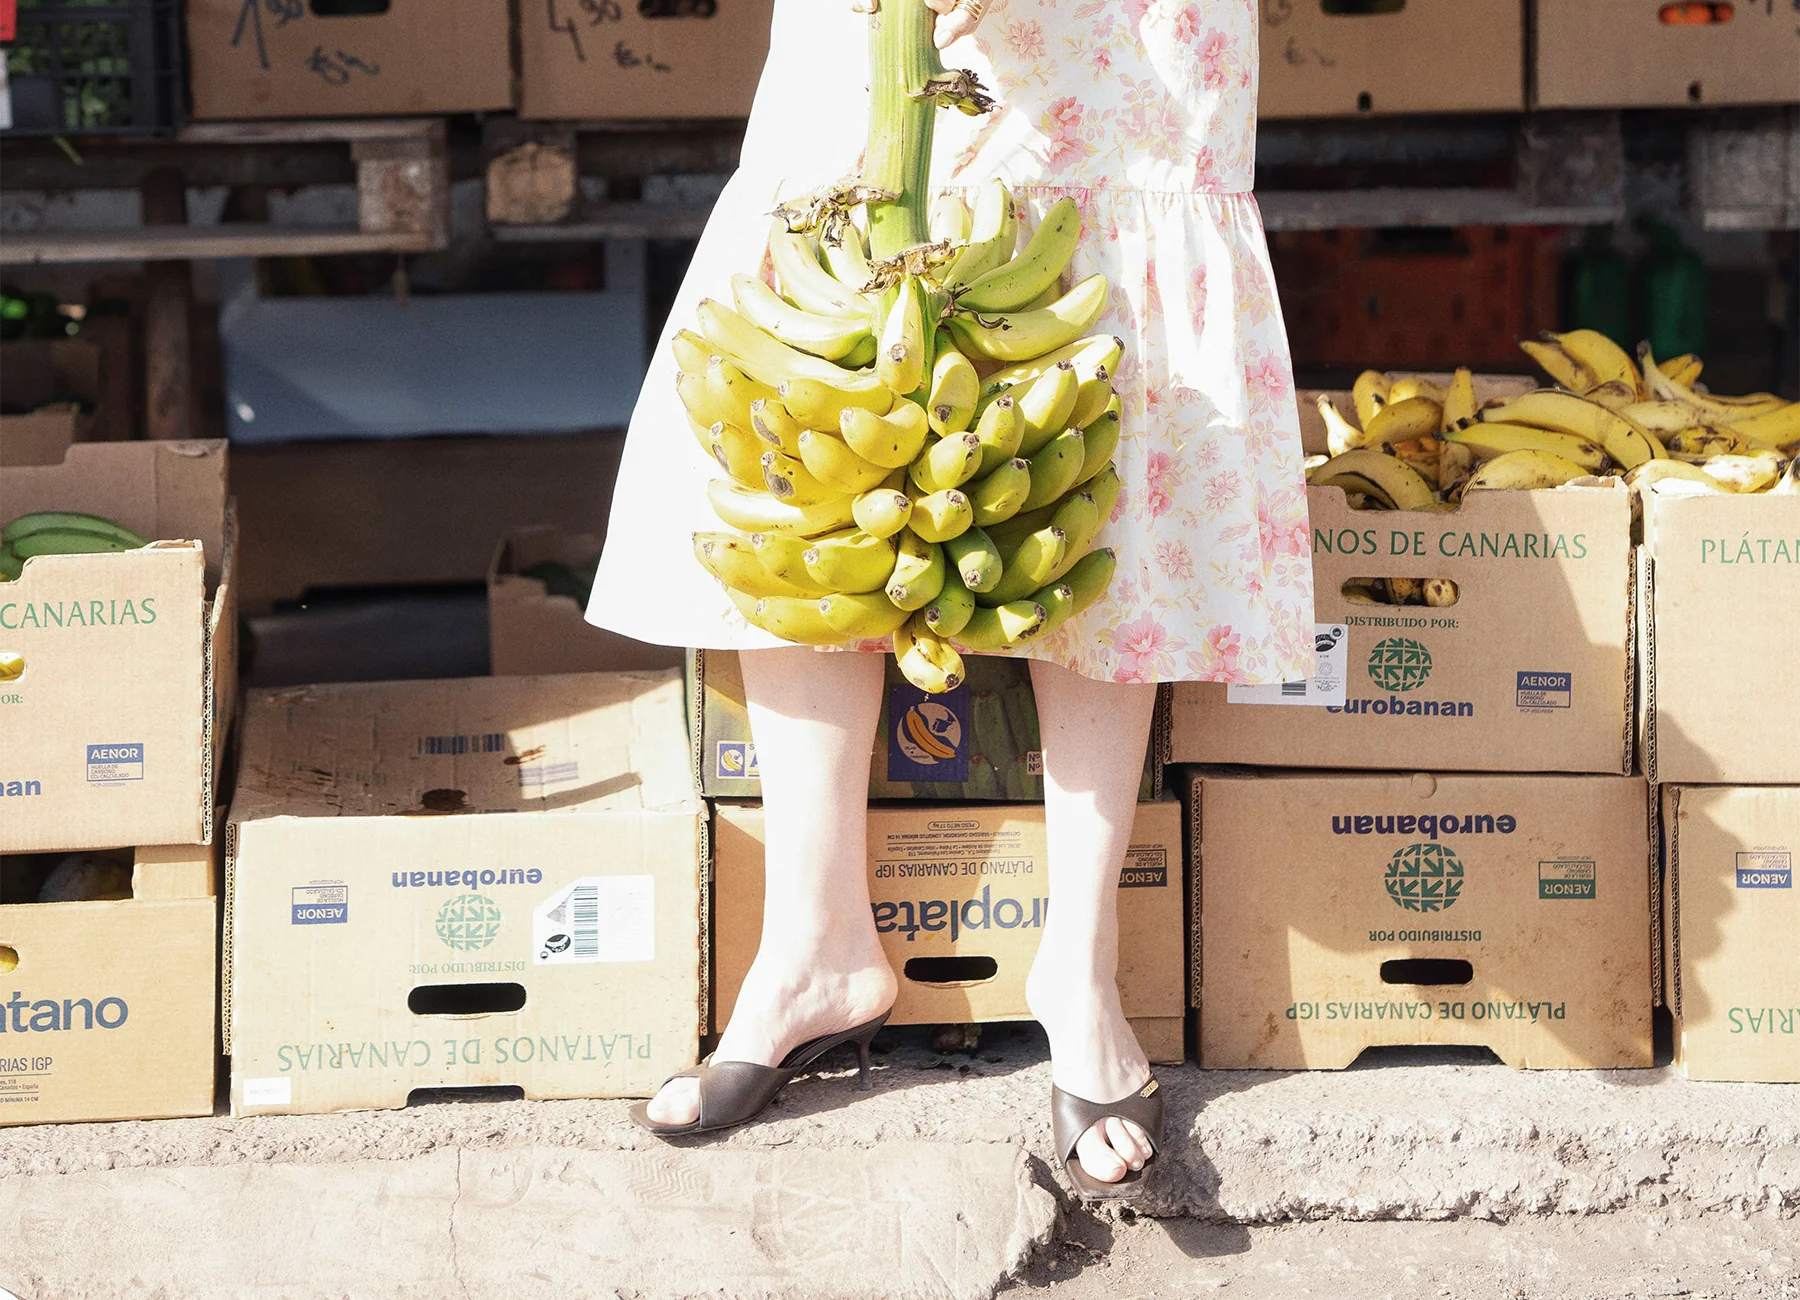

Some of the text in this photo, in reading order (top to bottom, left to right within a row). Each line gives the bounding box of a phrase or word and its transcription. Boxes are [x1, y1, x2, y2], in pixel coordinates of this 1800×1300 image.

[1390, 531, 1427, 556] DE
[1438, 532, 1588, 559] CANARIAS
[1701, 531, 1800, 564] PLÁTA
[0, 598, 157, 629] CANARIAS
[1344, 615, 1460, 629] DISTRIBUIDO POR:
[1521, 676, 1566, 687] AENOR
[91, 748, 138, 760] AENOR
[1332, 814, 1517, 840] eurobanan
[875, 861, 1033, 878] PLÁTANO DE CANARIAS IGP
[392, 868, 543, 891] eurobanan
[1742, 873, 1788, 884] AENOR
[1544, 884, 1592, 894] AENOR
[297, 908, 344, 920] AENOR
[871, 884, 1048, 943] ropláta
[1369, 930, 1482, 942] DISTRIBUIDO POR
[408, 960, 526, 974] DISTRIBUIDO POR:
[1285, 1001, 1566, 1024] PLÁTANO DE CANARIAS IGP
[1728, 1007, 1800, 1034] RIAS
[276, 1033, 653, 1072] PLÁTANOS DE CANARIAS
[31, 1056, 53, 1071] IGP
